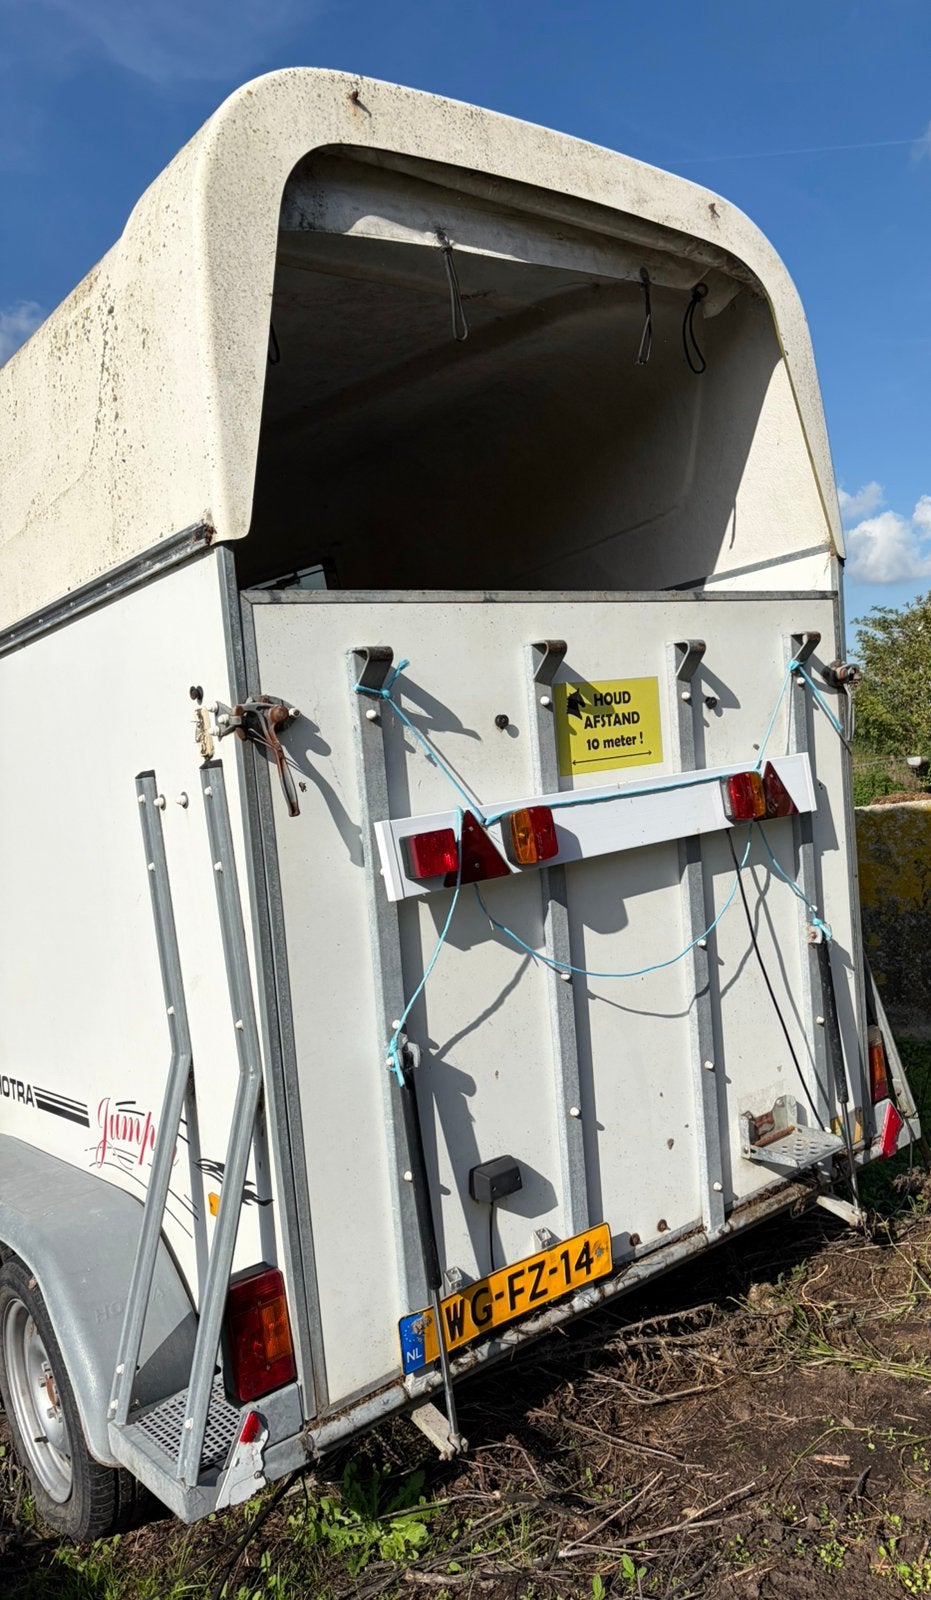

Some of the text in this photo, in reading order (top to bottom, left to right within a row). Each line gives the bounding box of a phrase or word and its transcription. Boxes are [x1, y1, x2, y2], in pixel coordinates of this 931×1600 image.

[593, 691, 631, 706] HOUD
[583, 711, 641, 730] AFSTAND
[586, 738, 600, 751] 10
[0, 1073, 36, 1109] OTRA
[444, 1240, 596, 1343] WG-FZ-14
[406, 1347, 423, 1364] NL
